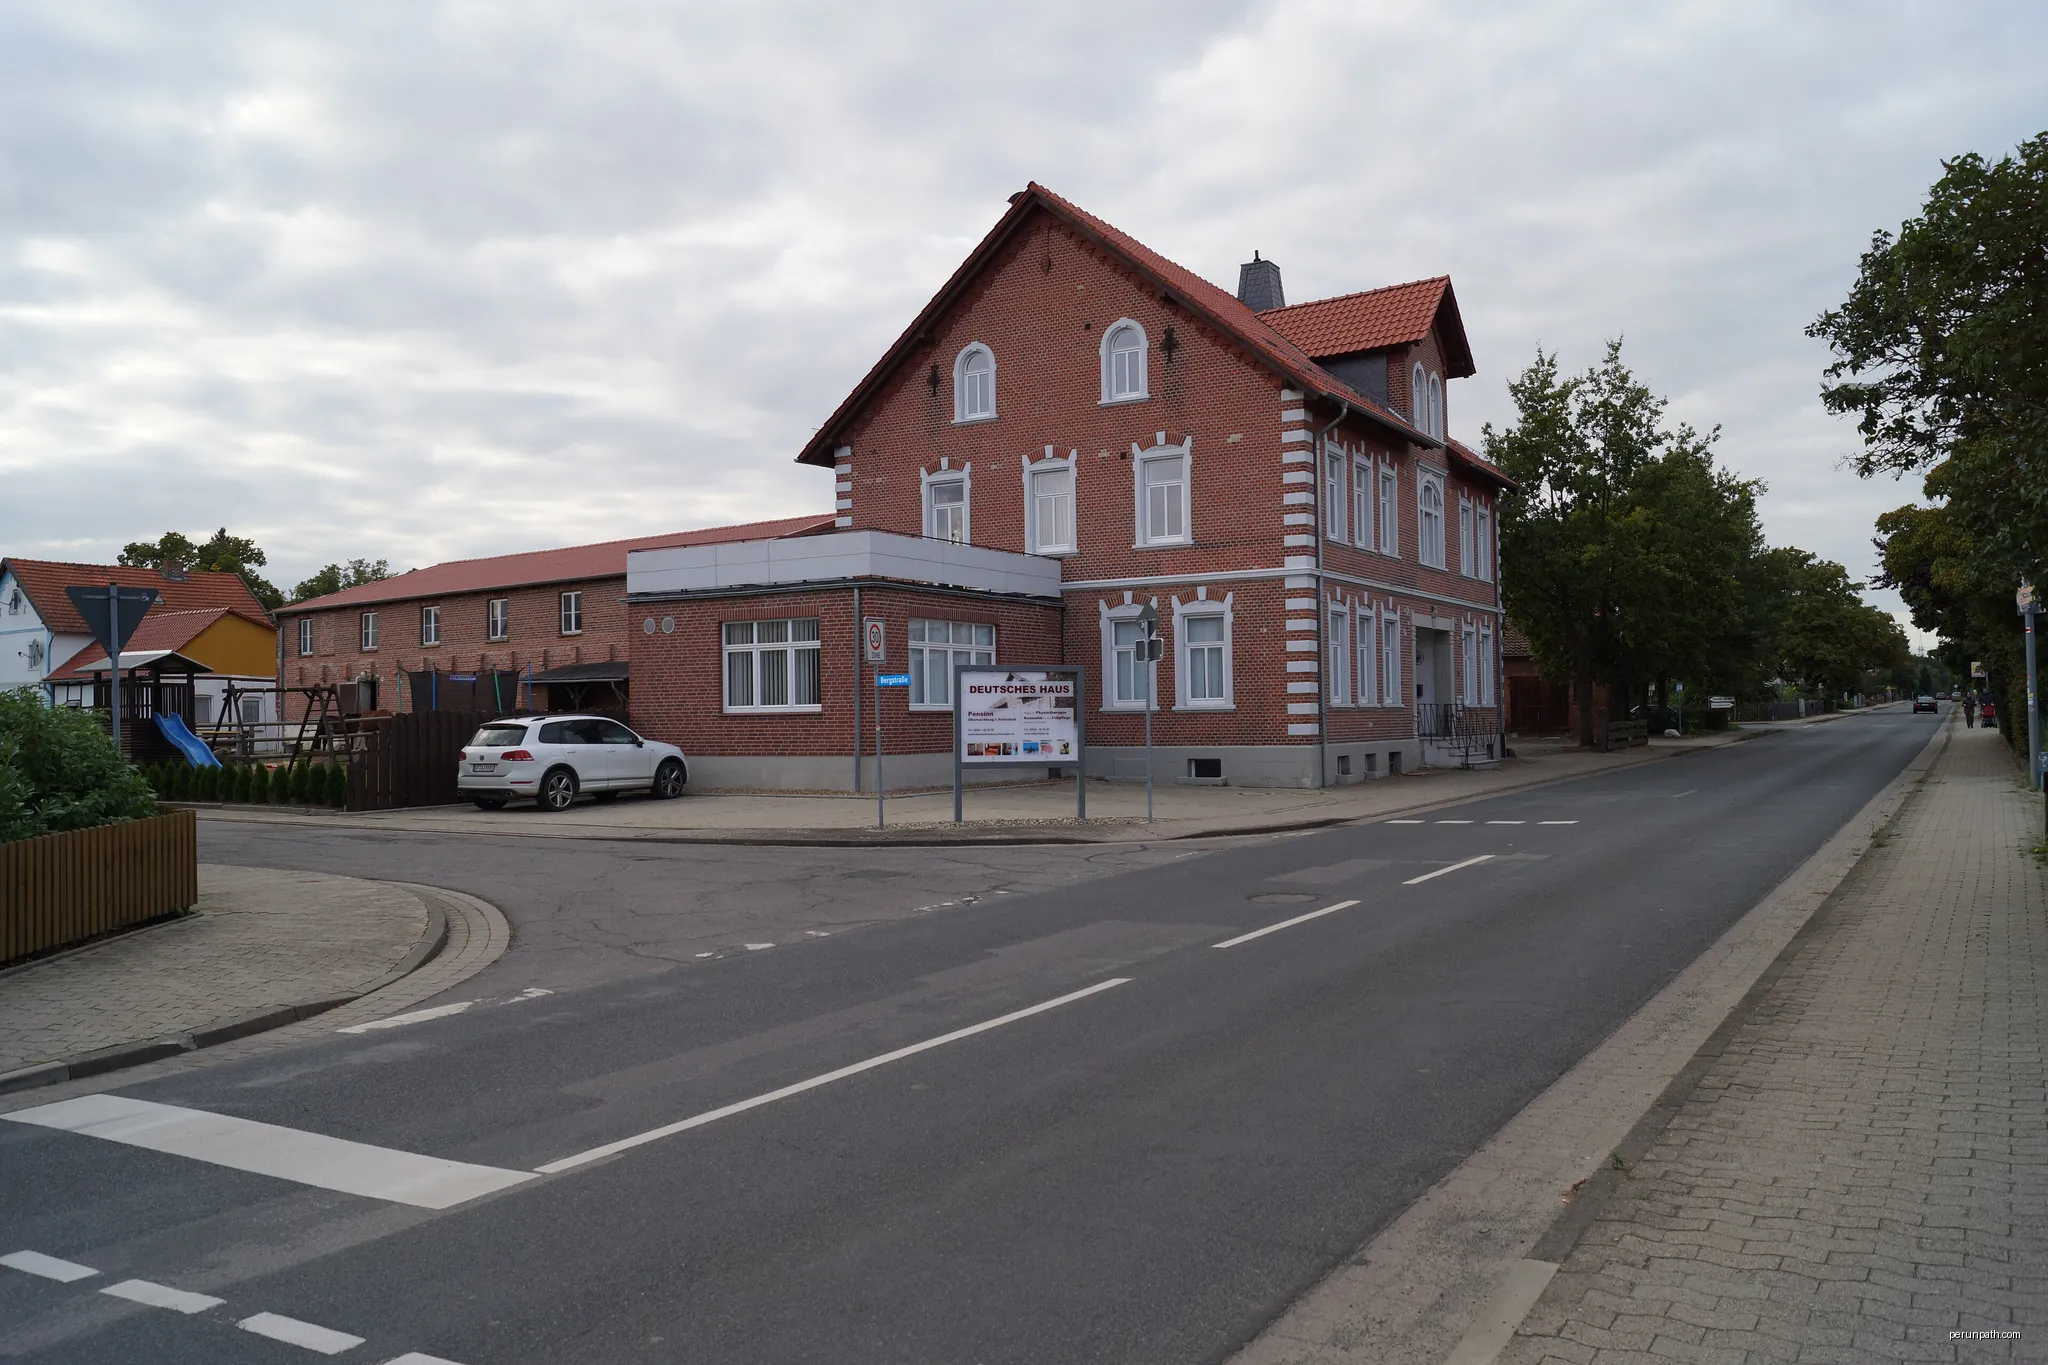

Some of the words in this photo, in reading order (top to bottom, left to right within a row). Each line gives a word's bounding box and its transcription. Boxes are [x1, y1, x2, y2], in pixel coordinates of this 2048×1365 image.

[872, 631, 879, 643] 30
[881, 676, 908, 685] Bergstraße
[969, 685, 1036, 694] DEUTSCHES
[1040, 685, 1070, 694] HAUS
